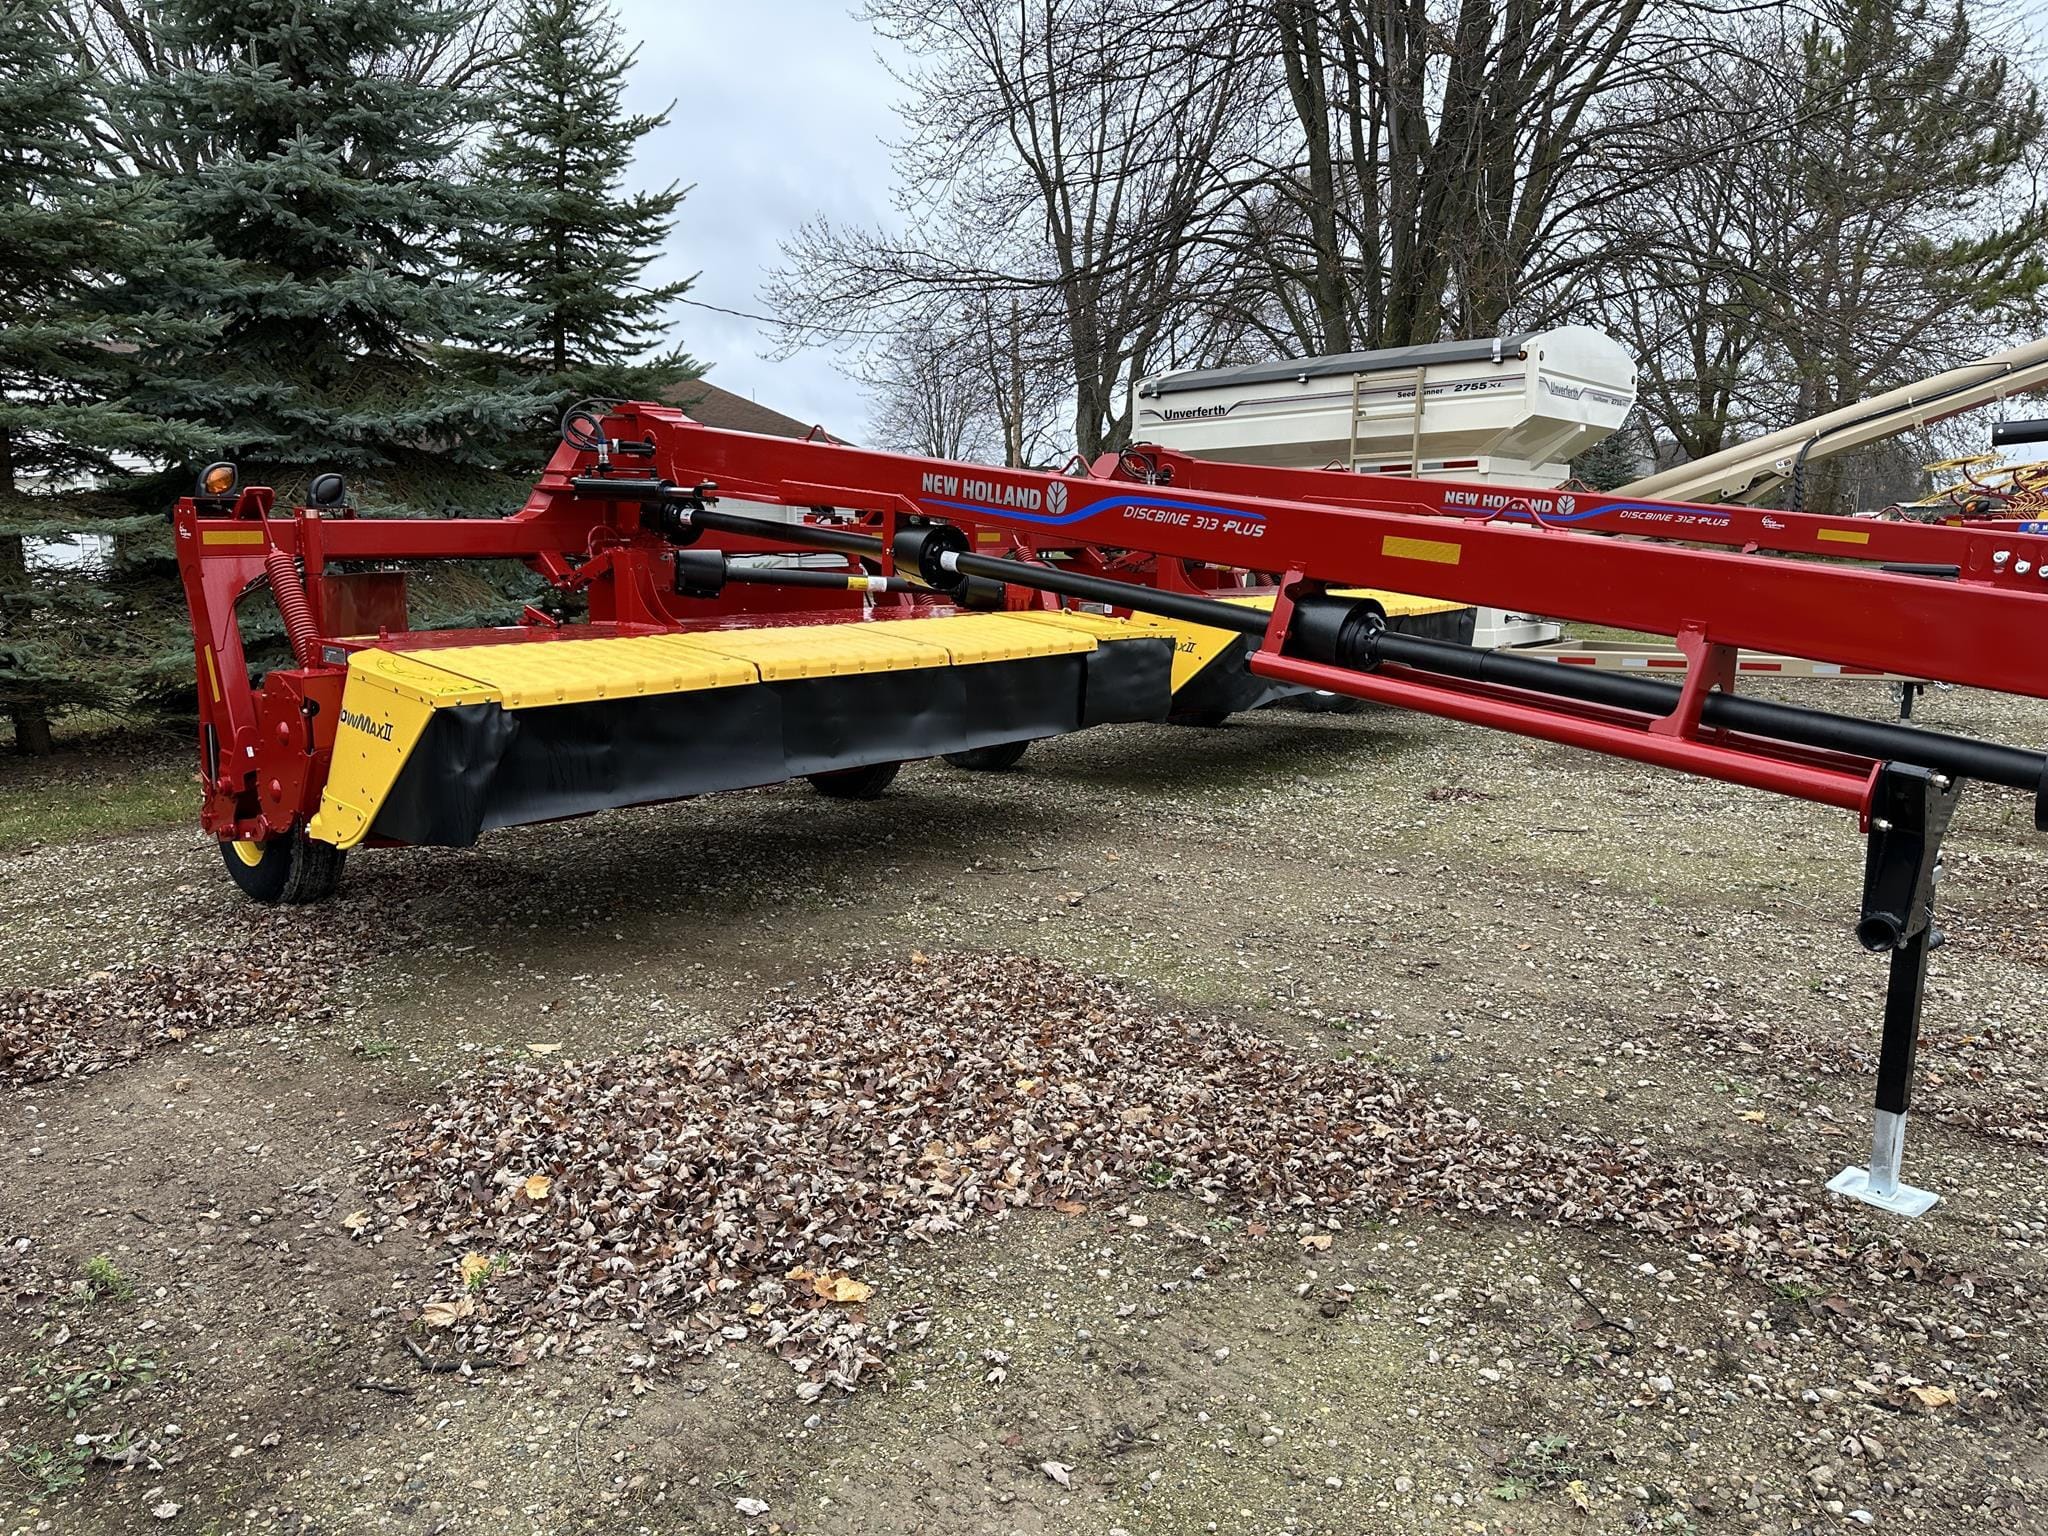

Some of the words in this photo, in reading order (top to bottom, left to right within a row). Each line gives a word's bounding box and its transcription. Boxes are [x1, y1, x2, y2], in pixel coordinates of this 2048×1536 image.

[1454, 382, 1488, 393] 2755
[1164, 405, 1226, 420] Unverferth
[922, 472, 959, 497] NEW
[963, 478, 1042, 510] HOLLAND
[1444, 490, 1479, 506] NEW
[1123, 506, 1191, 526] DISCBINE
[1193, 516, 1219, 531] 313
[1619, 510, 1673, 522] DISCBINE
[1675, 514, 1696, 524] 312
